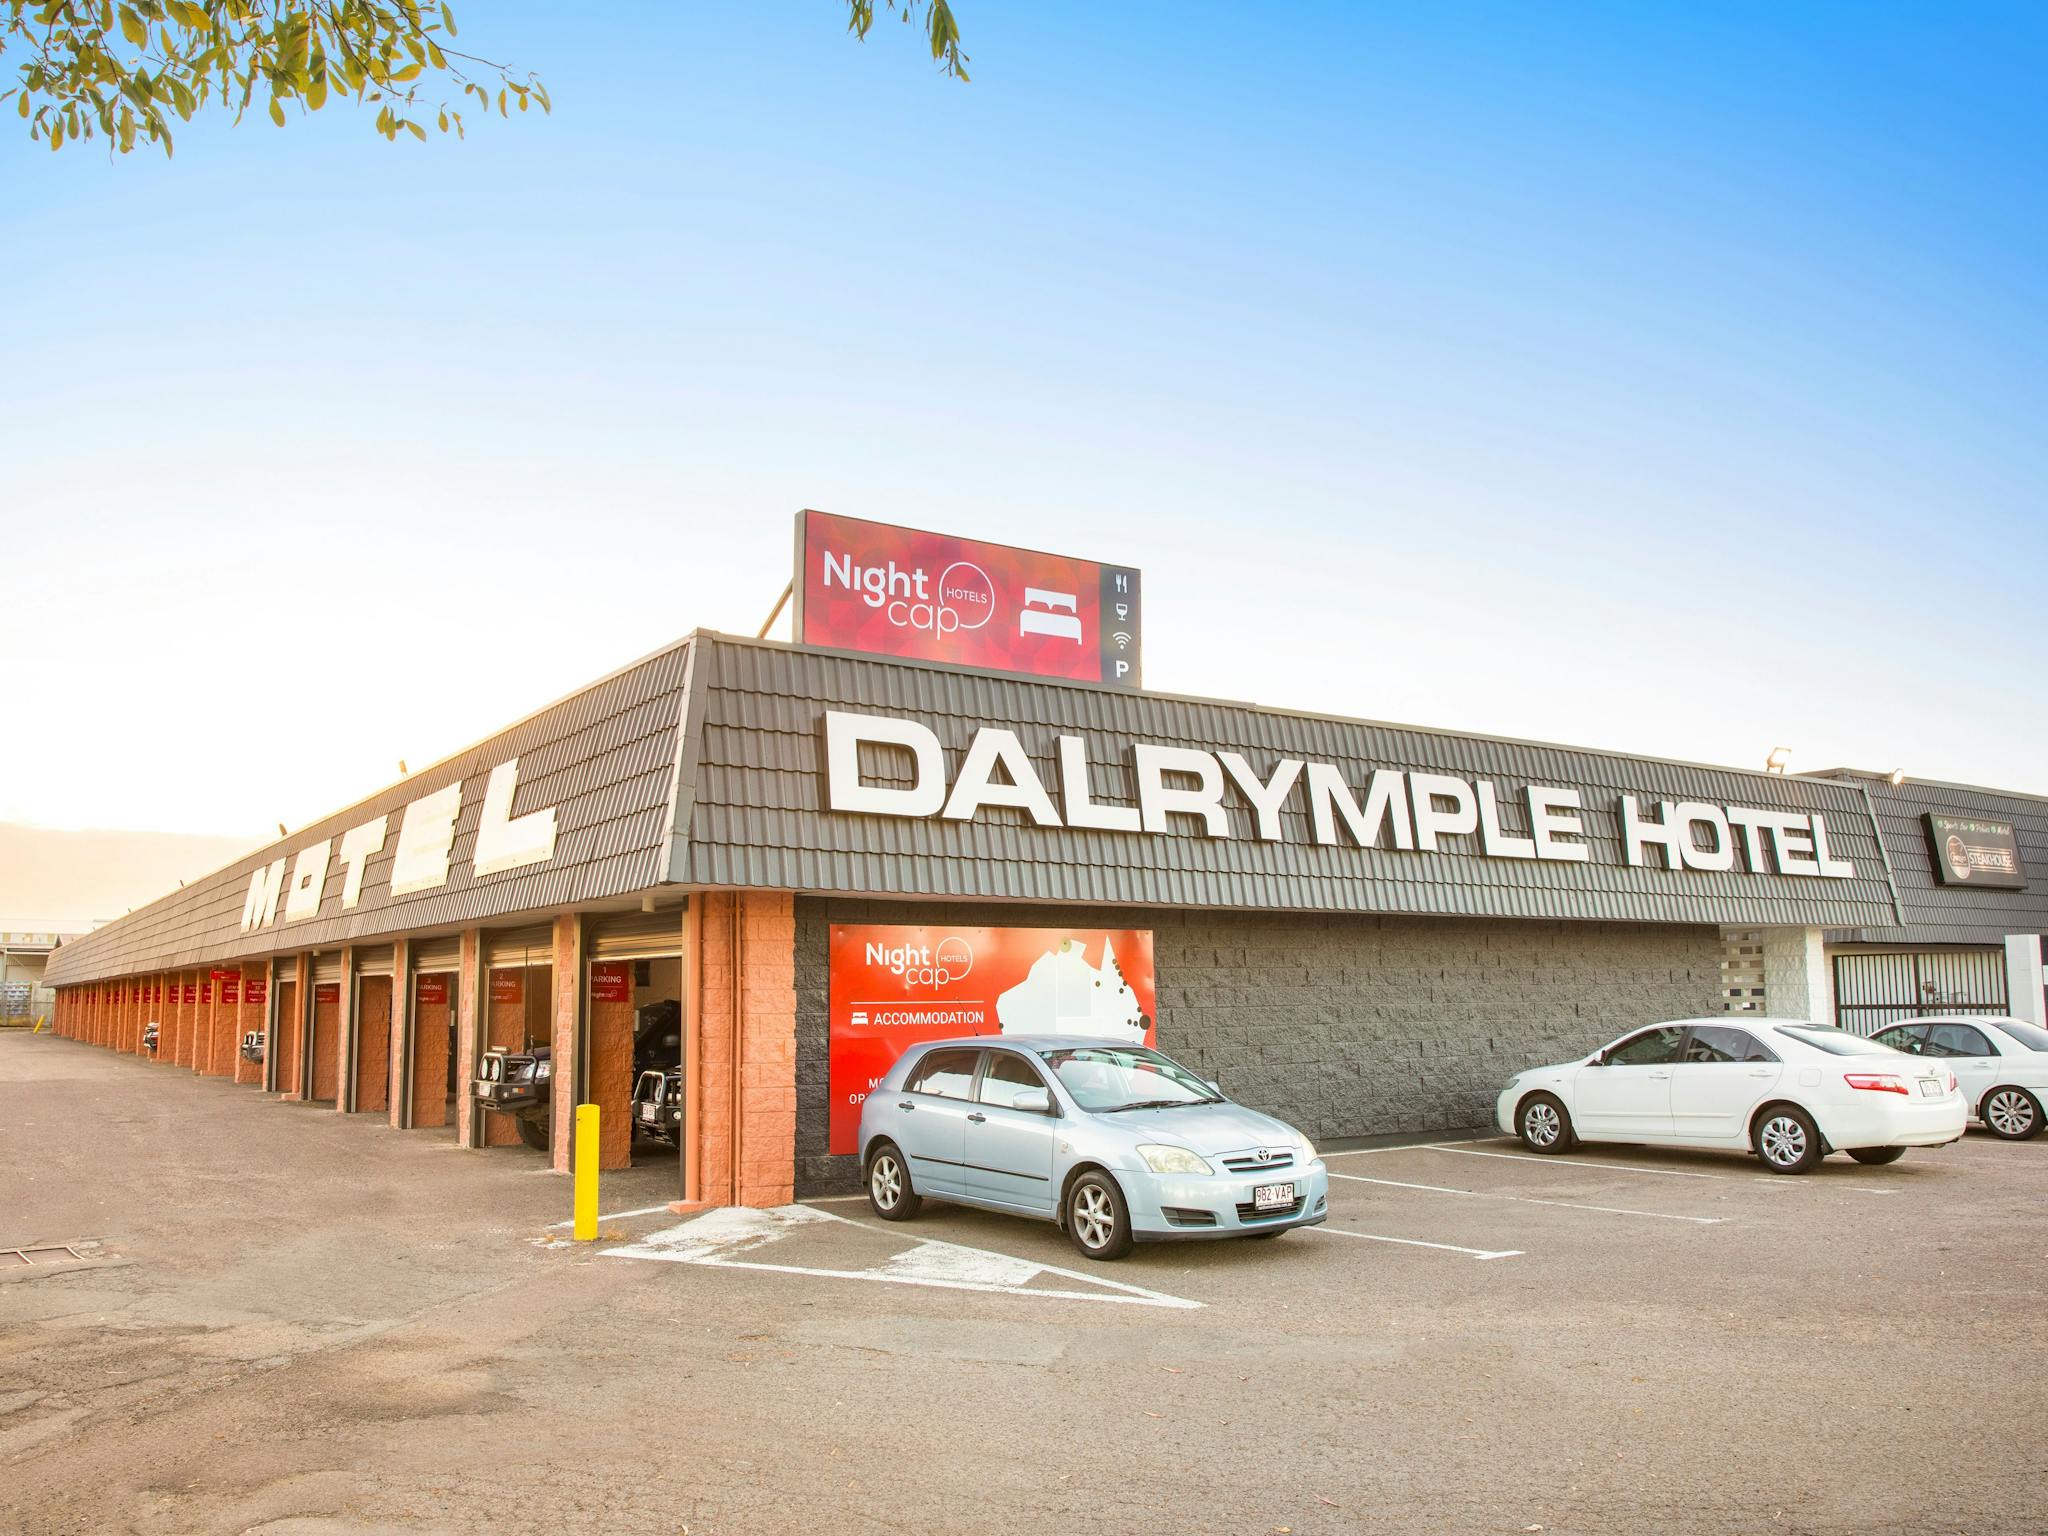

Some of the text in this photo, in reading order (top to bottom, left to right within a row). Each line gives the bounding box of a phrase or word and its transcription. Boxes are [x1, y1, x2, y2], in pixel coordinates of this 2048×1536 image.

[823, 551, 929, 608] Night
[946, 587, 988, 605] HOTELS
[888, 601, 960, 640] cap
[1116, 660, 1129, 678] P
[824, 710, 1854, 879] DALRYMPLE HOTEL
[240, 757, 559, 934] MOTEL
[1969, 852, 2013, 867] STEAKHOUSE
[866, 942, 931, 975] Night
[940, 954, 968, 963] HOTELS
[906, 965, 950, 990] cap
[873, 1010, 985, 1025] ACCOMMODATION
[849, 1093, 868, 1105] OP
[1257, 1185, 1292, 1201] 982 VAP
